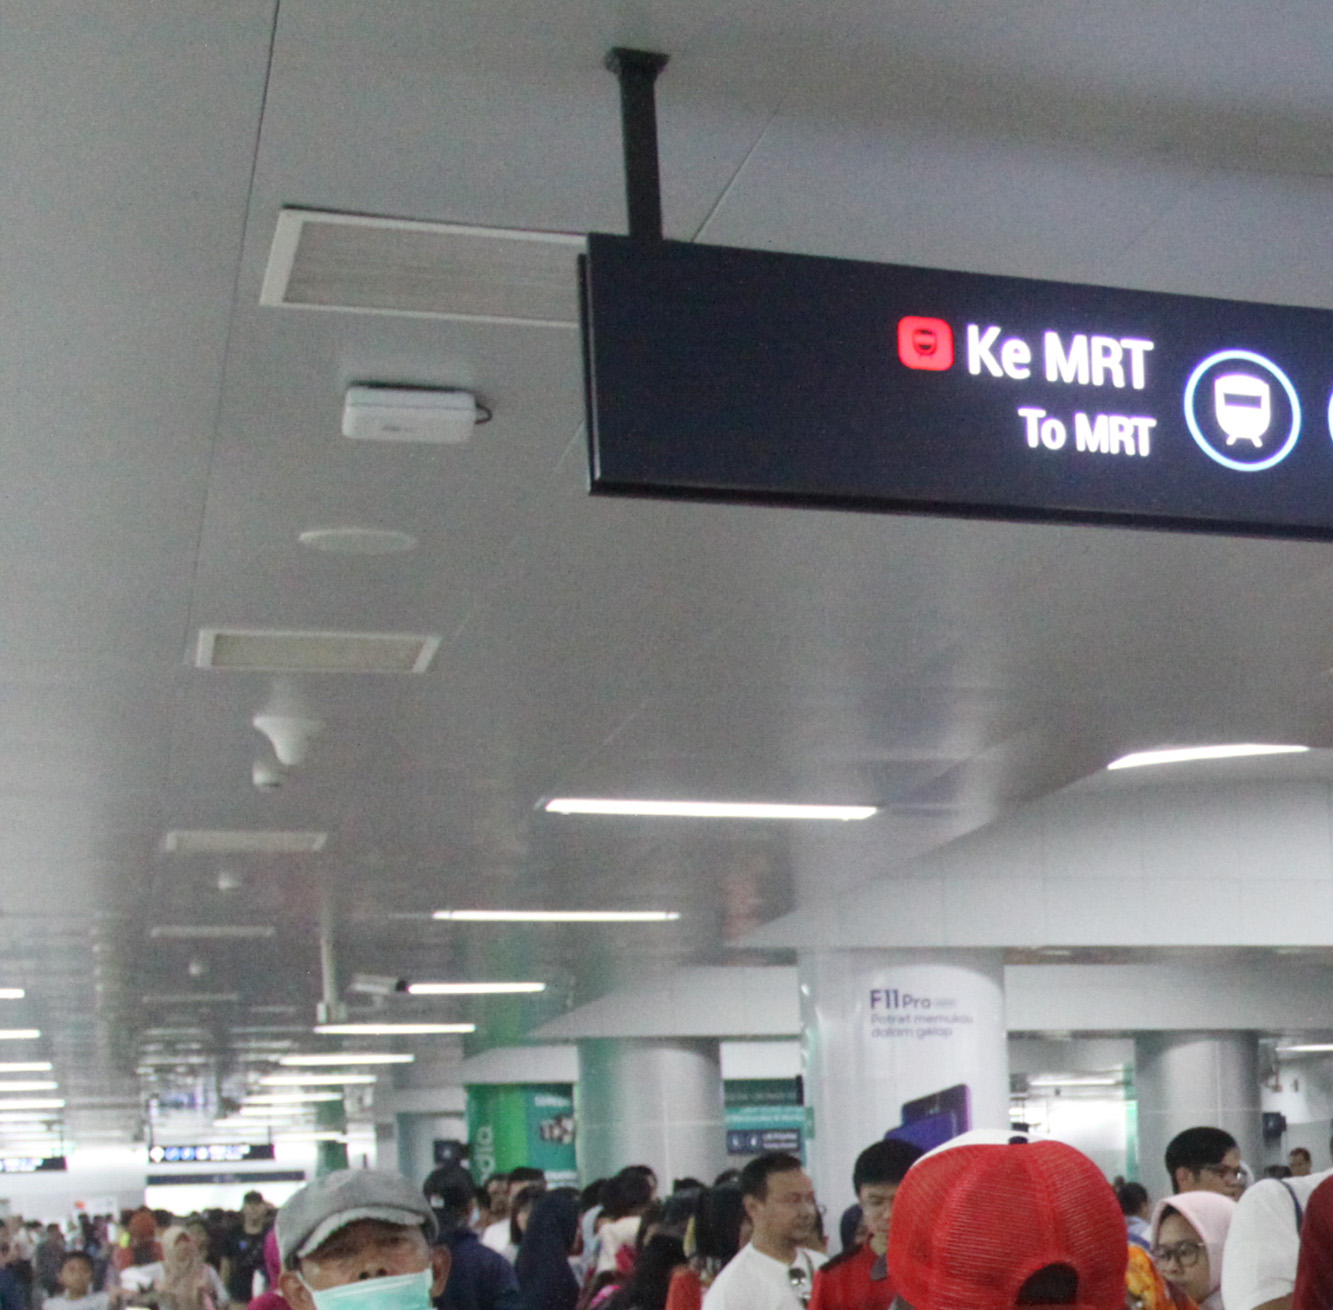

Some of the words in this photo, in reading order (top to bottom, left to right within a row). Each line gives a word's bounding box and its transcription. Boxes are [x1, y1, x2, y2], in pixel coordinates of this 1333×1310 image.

[966, 323, 1032, 380] Ke
[1043, 330, 1154, 390] MRT
[1017, 406, 1067, 450] To
[1074, 411, 1157, 457] MRT
[869, 988, 899, 1010] F11
[902, 993, 932, 1009] Pro
